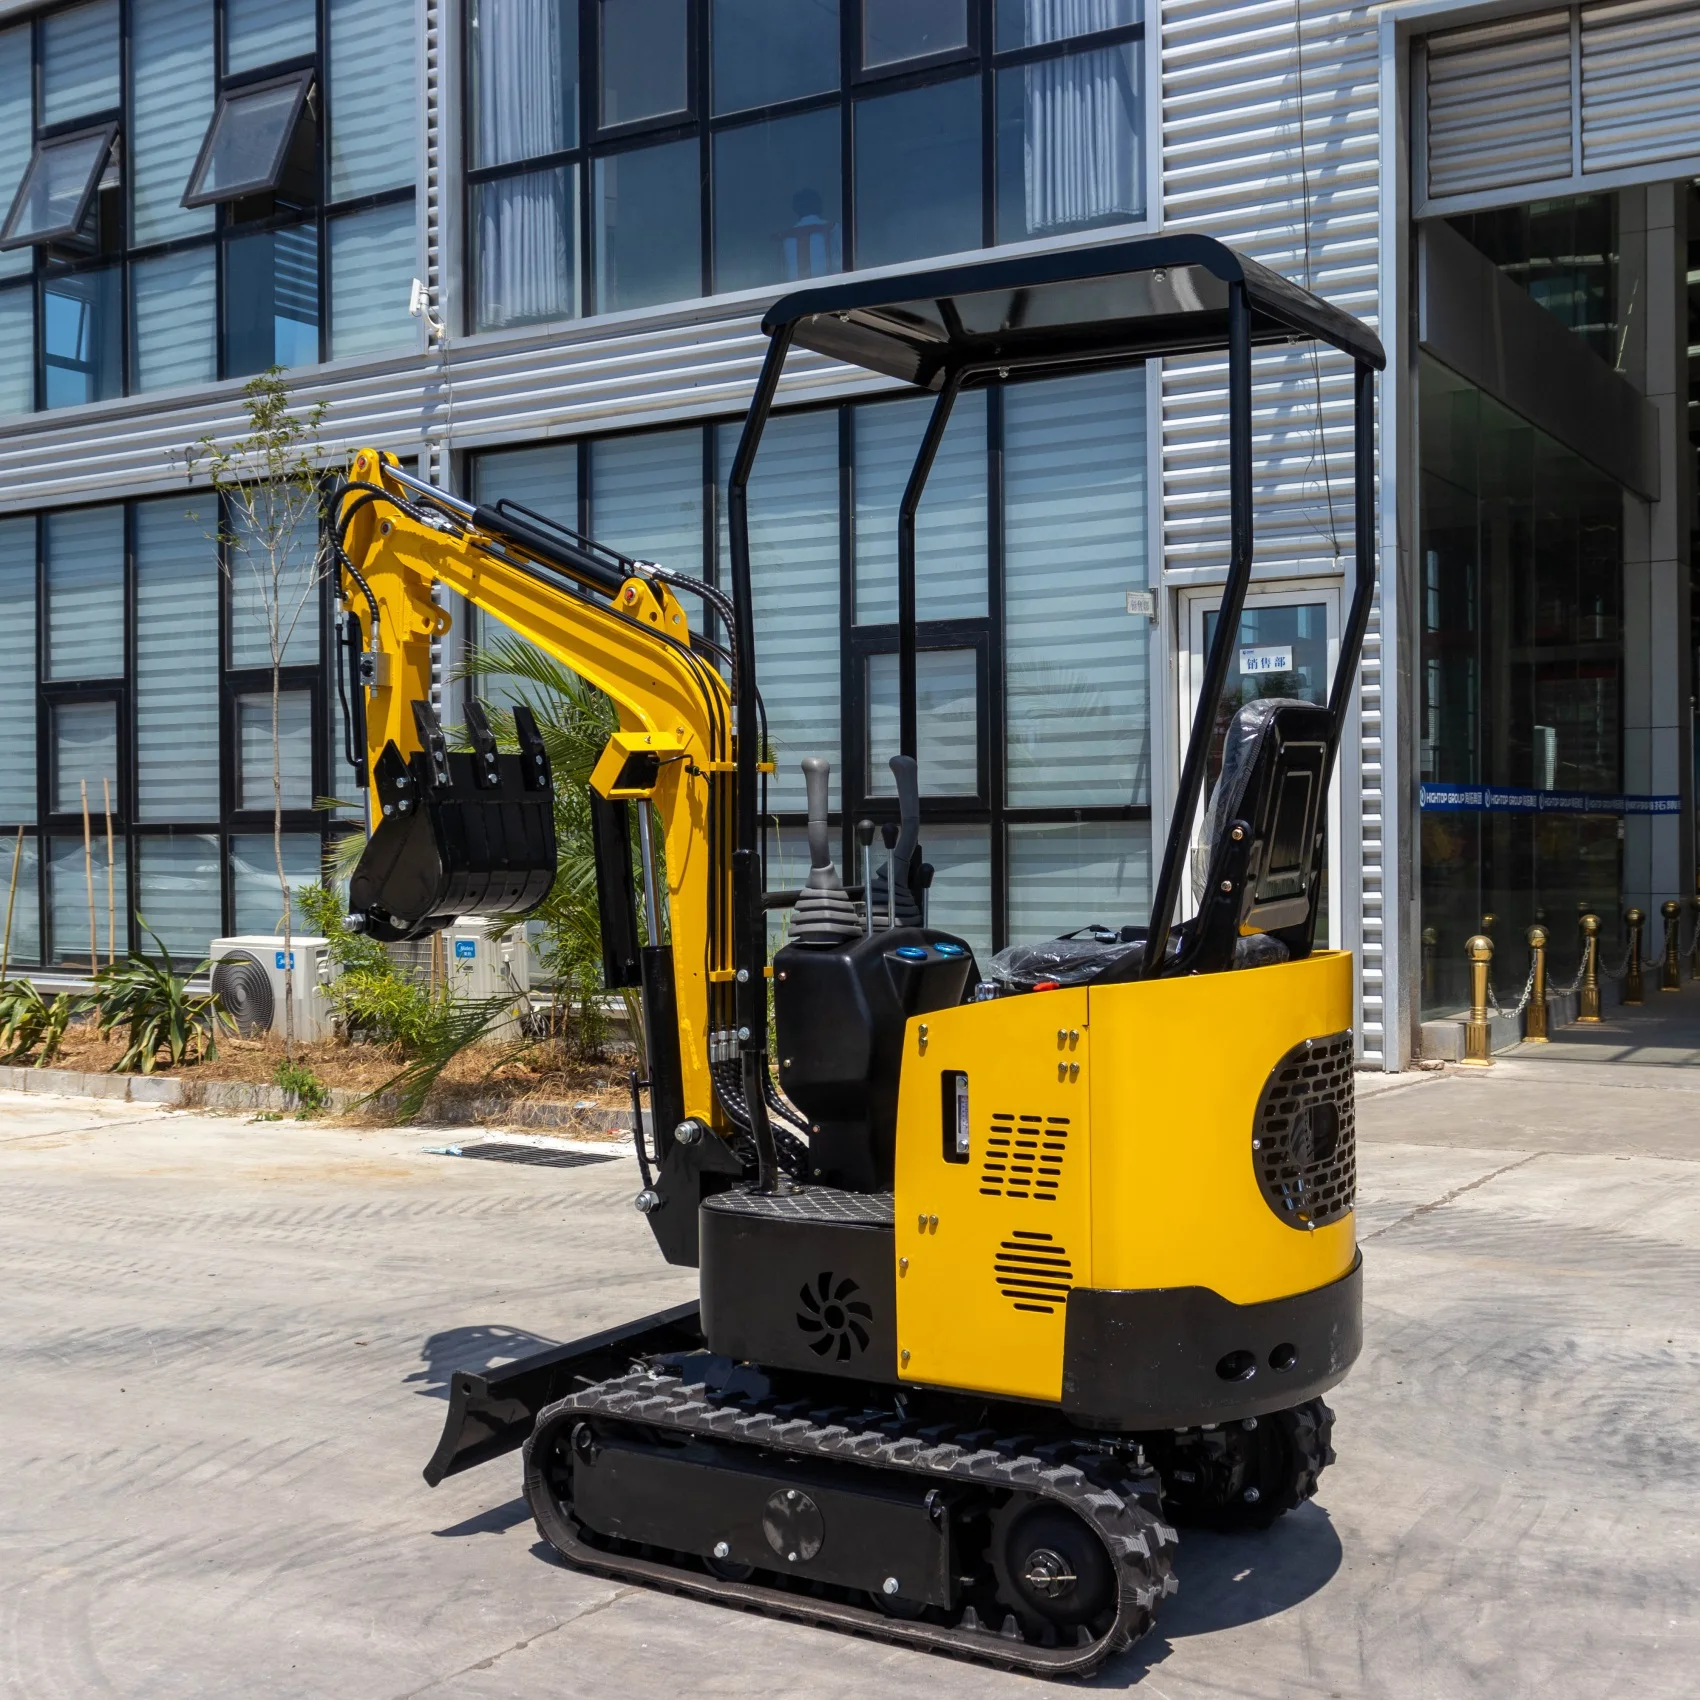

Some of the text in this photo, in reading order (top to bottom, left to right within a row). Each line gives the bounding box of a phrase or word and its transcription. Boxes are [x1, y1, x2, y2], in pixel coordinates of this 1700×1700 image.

[1247, 656, 1286, 670] 销售部
[1426, 792, 1447, 804] HIGHTOP
[1448, 793, 1465, 804] GROUP
